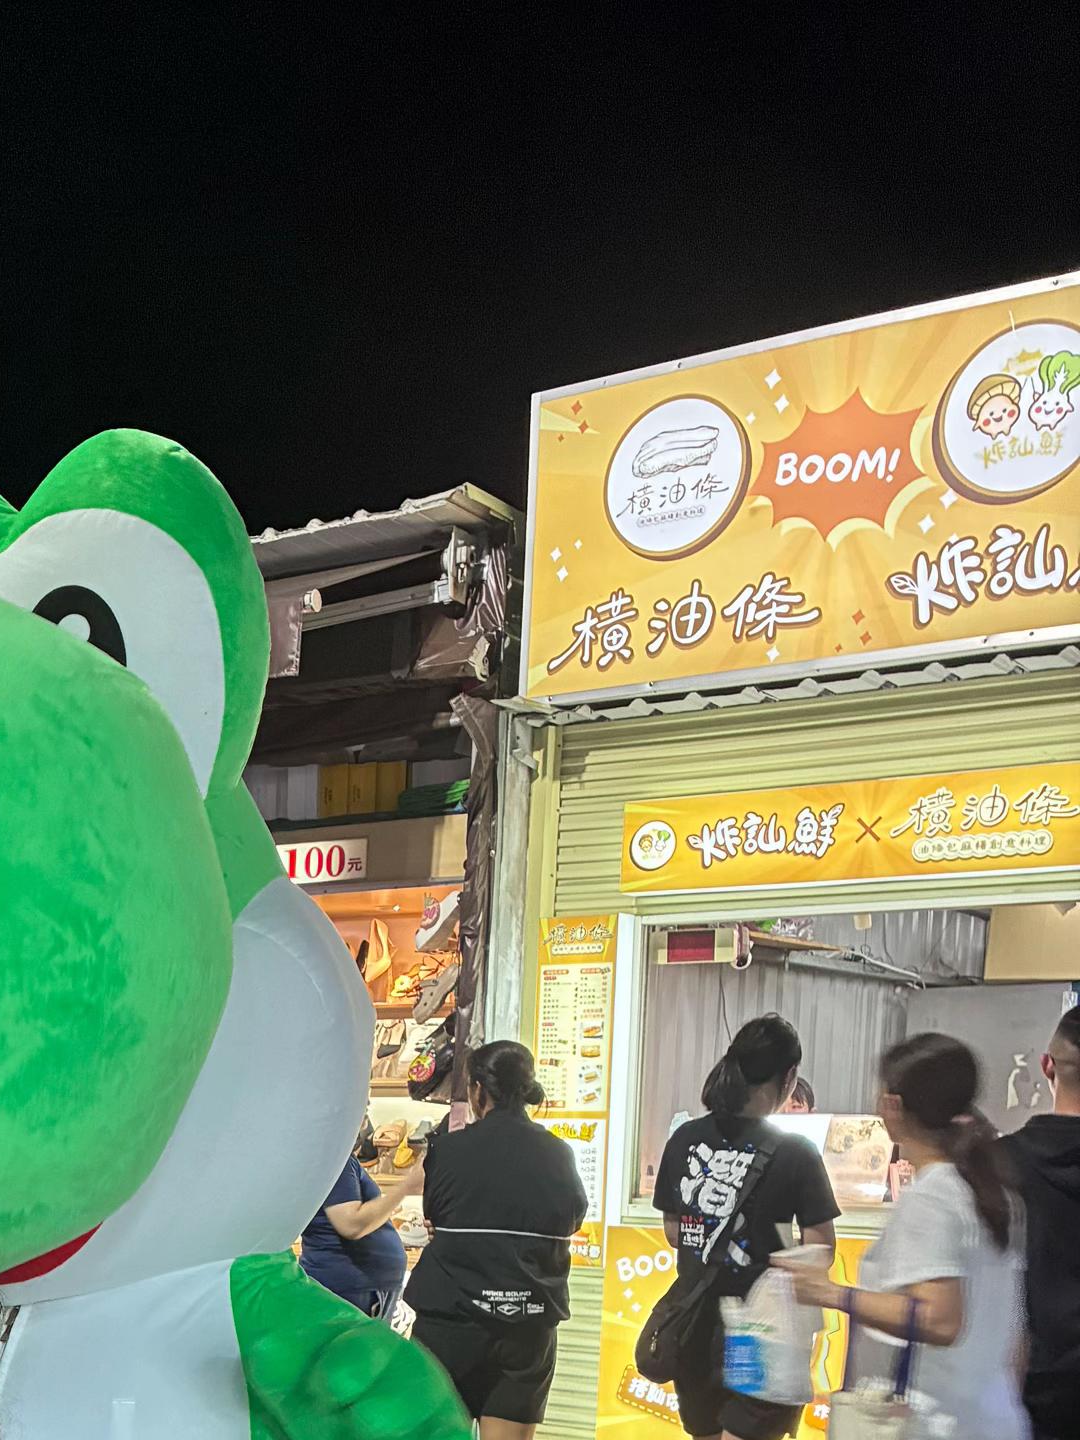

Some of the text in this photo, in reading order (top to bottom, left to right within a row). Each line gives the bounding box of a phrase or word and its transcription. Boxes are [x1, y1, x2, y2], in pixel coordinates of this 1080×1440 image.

[616, 473, 730, 518] 橫油條
[775, 446, 900, 486] BOOM!
[887, 523, 1080, 628] 炸訕
[547, 571, 822, 674] 橫油條
[687, 803, 845, 868] 炸訕鮮
[890, 784, 1080, 838] 橫油條
[616, 1250, 677, 1282] BOO
